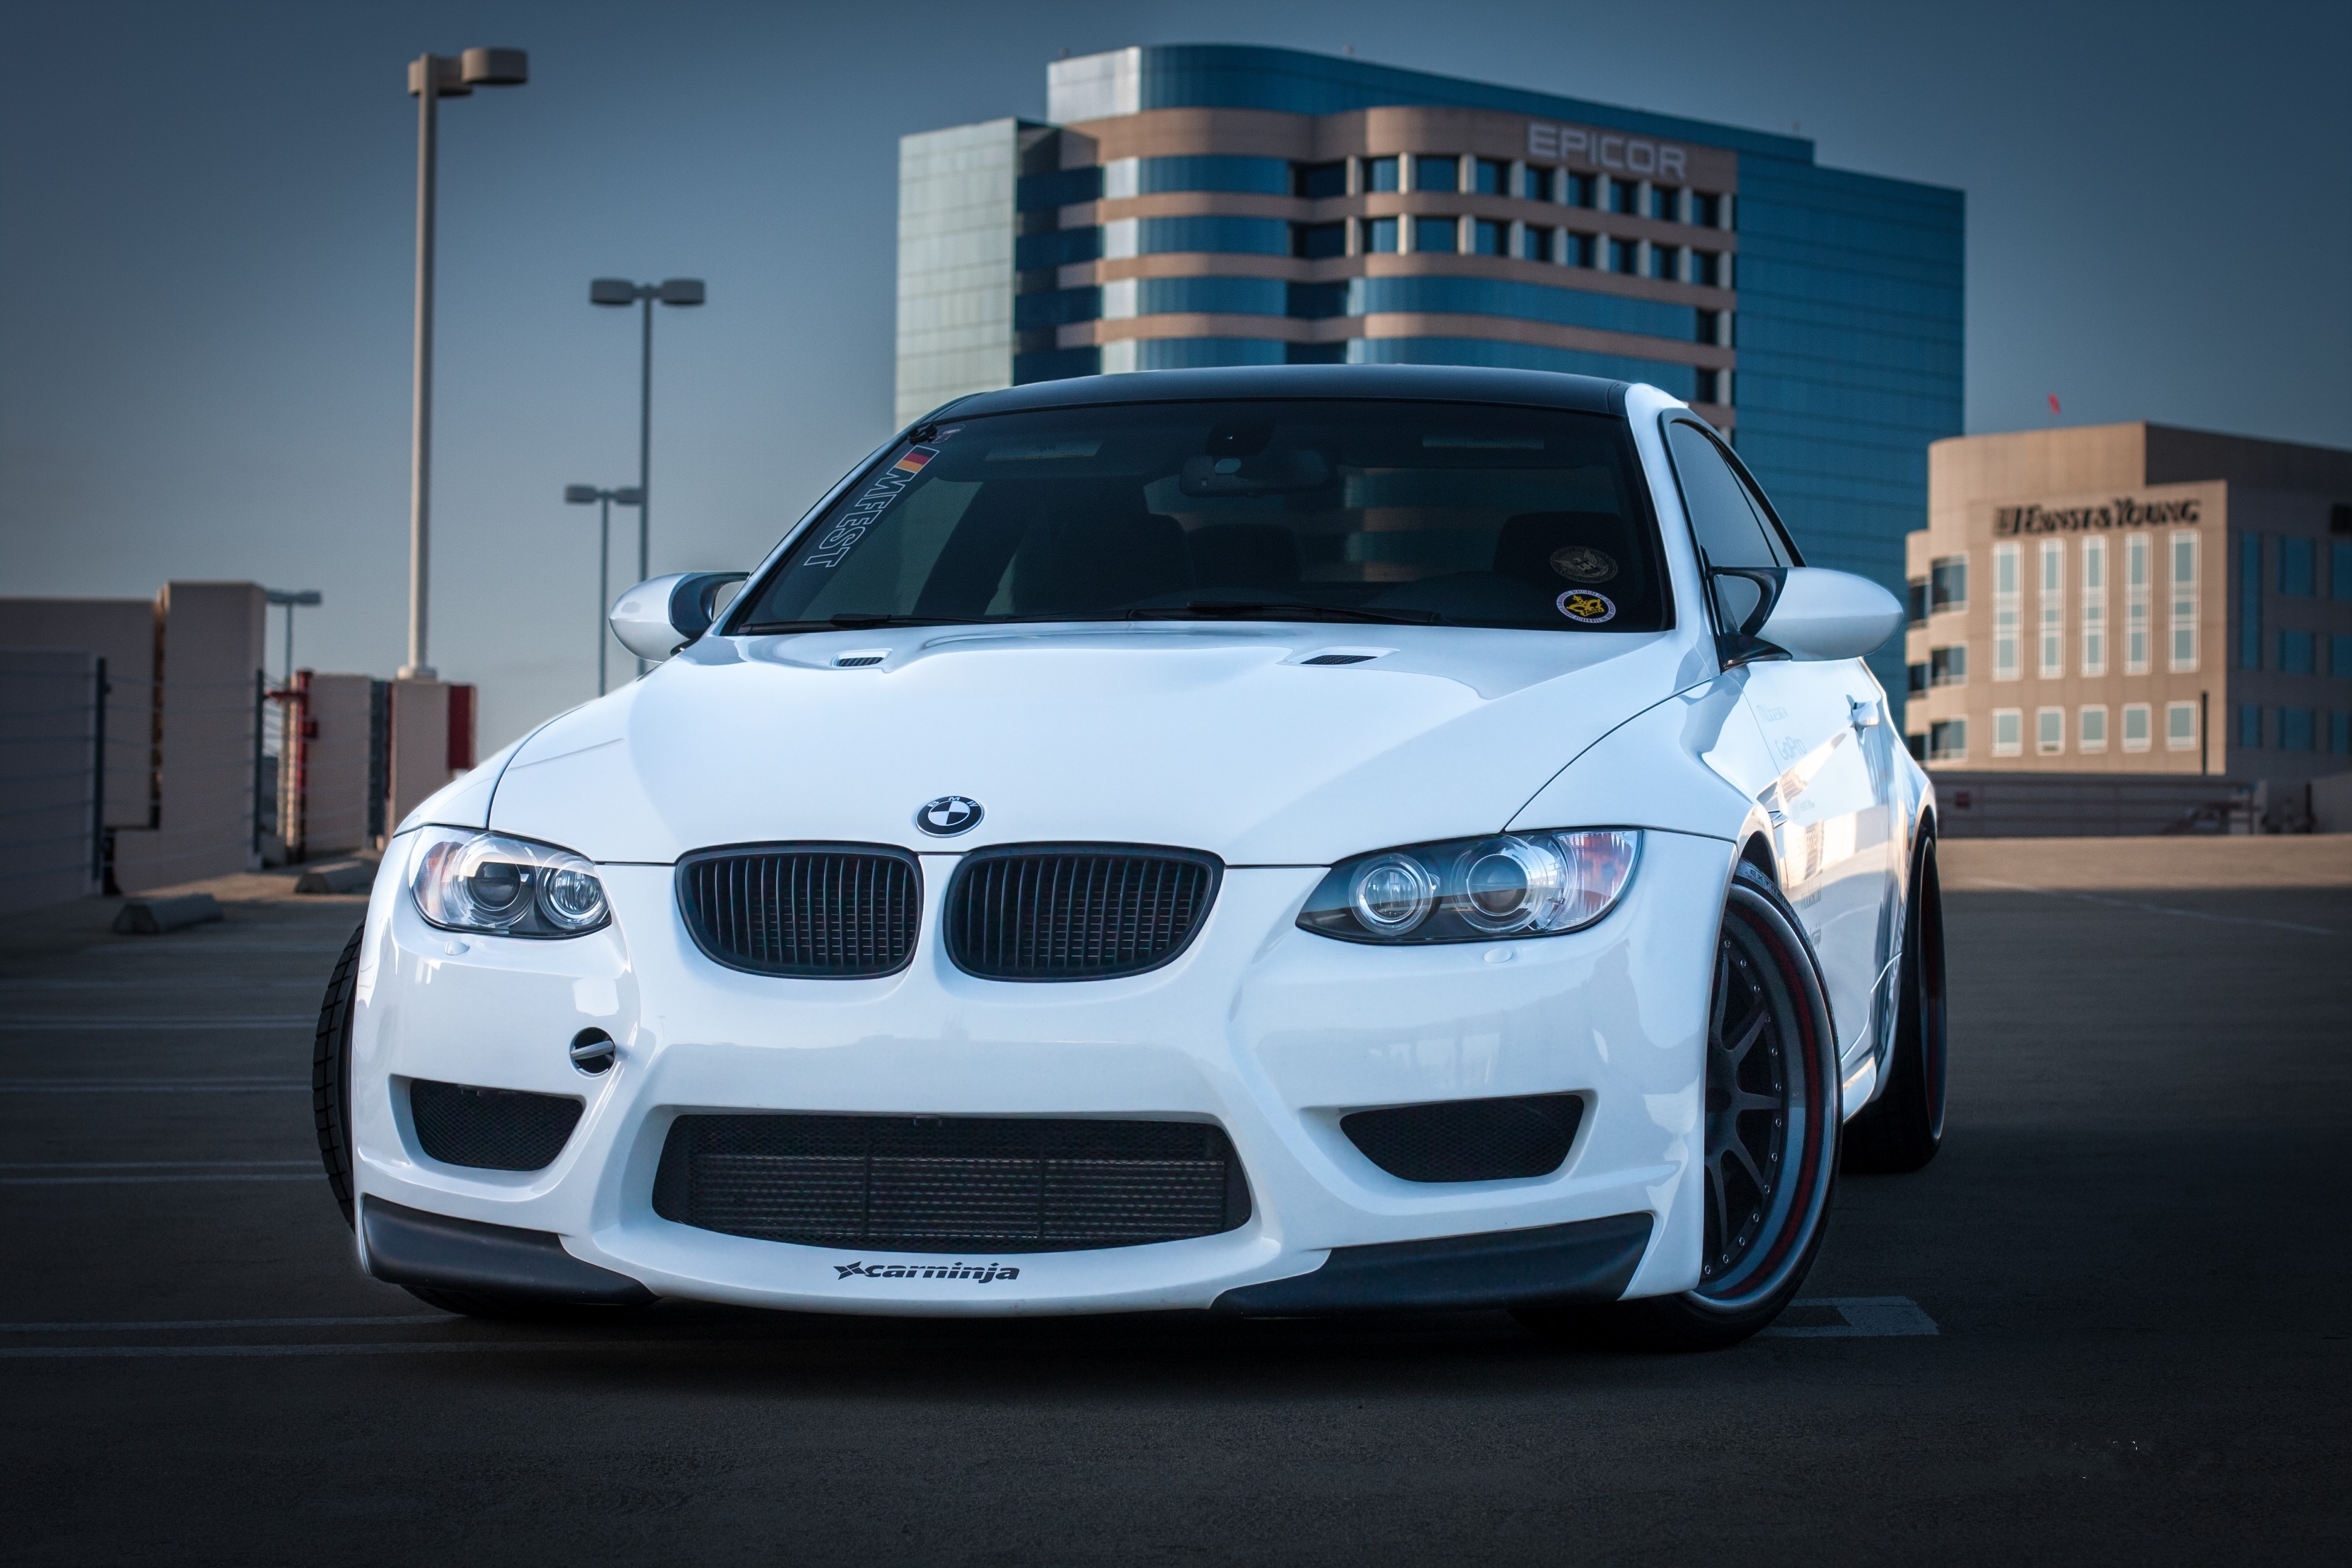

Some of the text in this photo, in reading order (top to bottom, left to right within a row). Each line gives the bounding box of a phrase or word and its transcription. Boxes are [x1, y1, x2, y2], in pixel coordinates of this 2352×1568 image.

[1528, 122, 1686, 179] EPICOR
[803, 466, 917, 567] MFEST
[927, 796, 979, 808] BMW
[863, 1261, 1020, 1284] carninja
